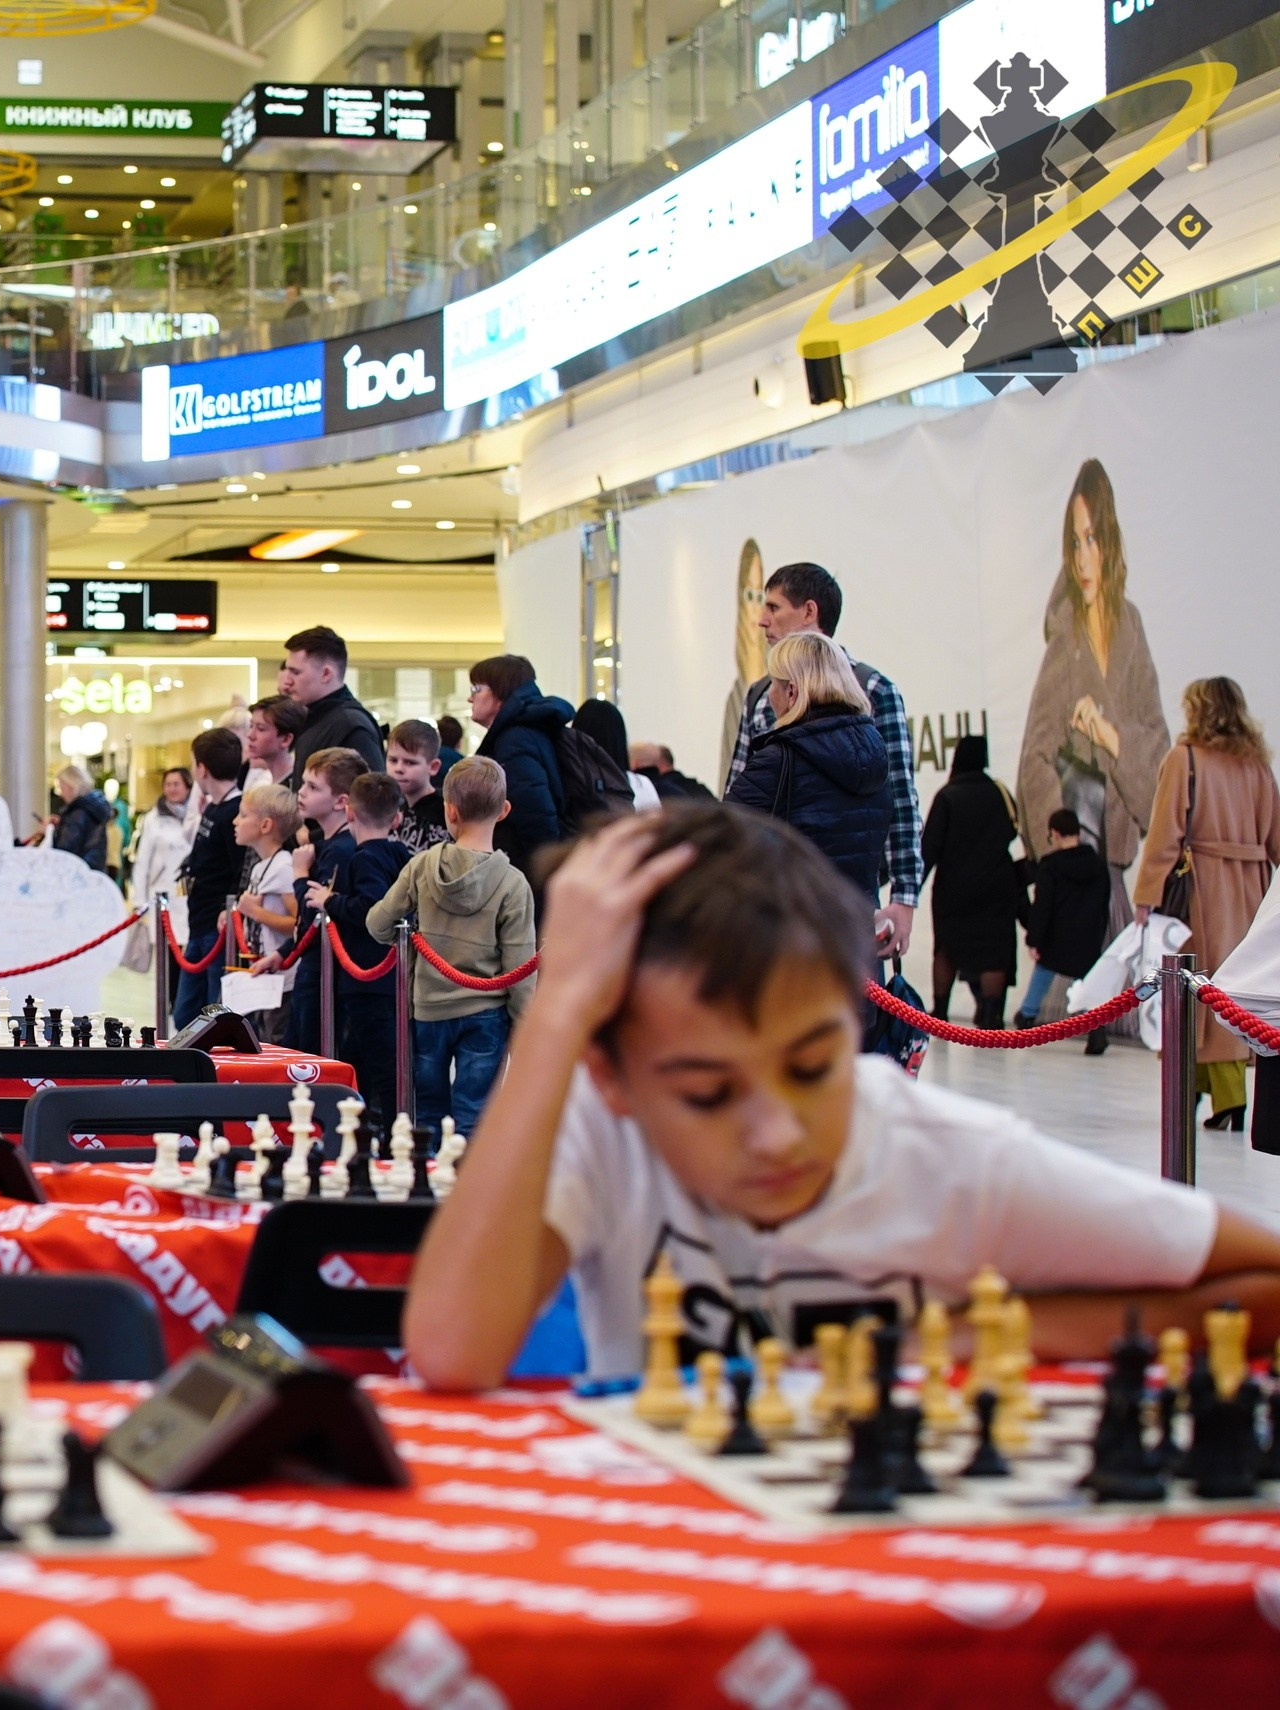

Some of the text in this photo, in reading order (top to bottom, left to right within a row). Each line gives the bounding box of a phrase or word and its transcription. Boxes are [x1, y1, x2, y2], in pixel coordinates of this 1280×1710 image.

[4, 104, 193, 129] КНИЖНЫЙ КЛУБ
[818, 64, 930, 186] familia
[201, 377, 322, 418] GOLFSTREAM
[60, 671, 153, 714] sela
